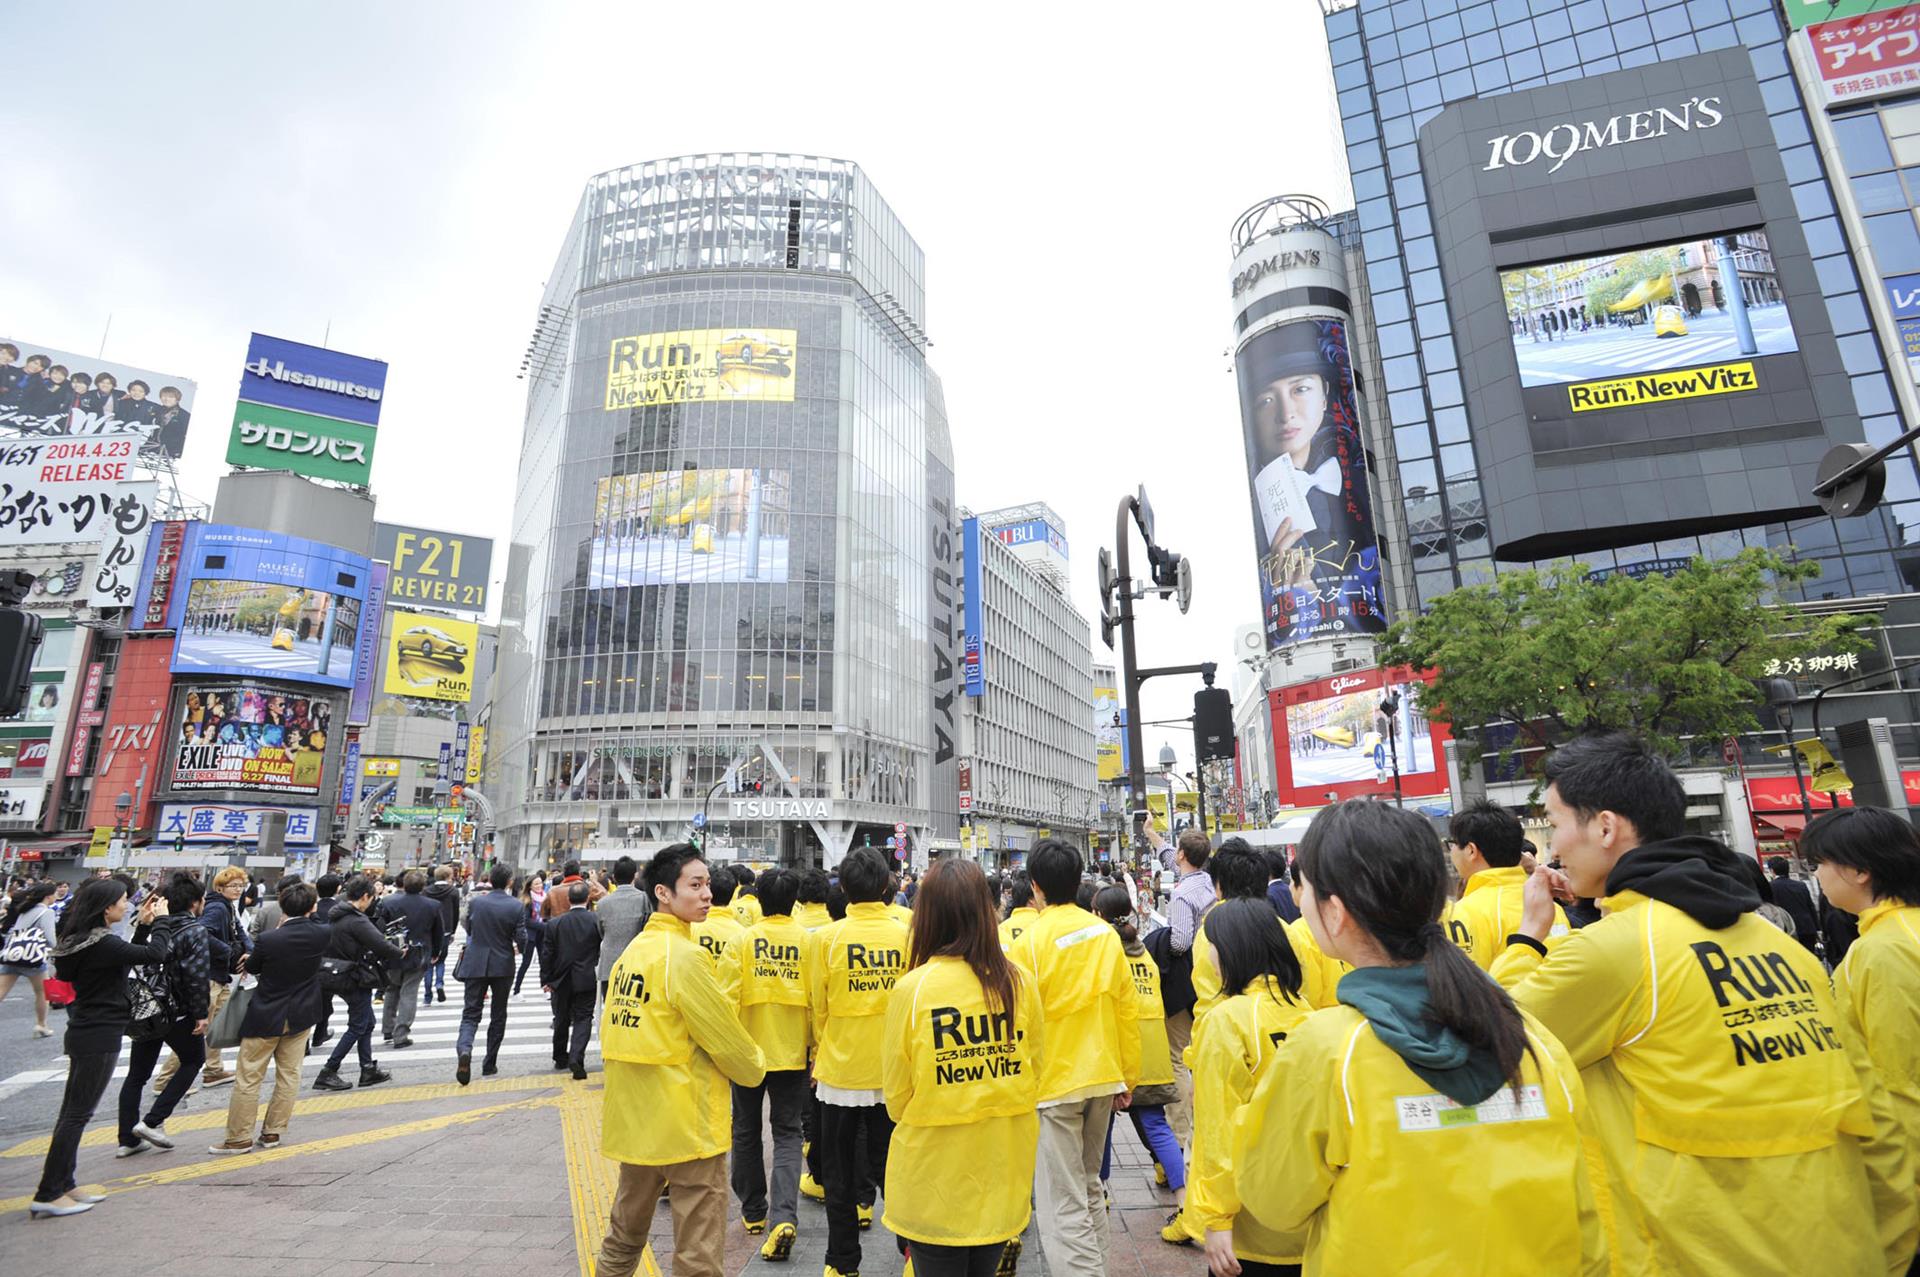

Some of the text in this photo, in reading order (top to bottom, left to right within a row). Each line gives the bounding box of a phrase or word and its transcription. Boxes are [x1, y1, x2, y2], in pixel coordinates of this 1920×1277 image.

[1823, 29, 1920, 69] アイフ
[245, 357, 382, 401] Hisamitsu
[1637, 378, 1697, 399] New
[1697, 368, 1754, 391] Vitz
[609, 380, 705, 407] New Vitz
[46, 442, 132, 459] 2014.4.23
[238, 421, 366, 464] サロンパス
[40, 463, 127, 482] RELEASE
[96, 493, 148, 603] もんじゃ
[393, 532, 463, 578] F21
[463, 586, 483, 605] 21
[933, 498, 955, 766] TSUTAYA
[966, 634, 980, 684] SEIBU
[1330, 677, 1366, 694] Glico
[19, 743, 49, 761] JTB
[101, 710, 162, 776] クスリ
[258, 747, 284, 759] NOW
[593, 745, 688, 758] STARBUCKS
[178, 746, 221, 770] EXILE
[244, 760, 259, 772] ON
[264, 773, 292, 784] FINAL
[733, 800, 829, 817] TSUTAYA
[754, 967, 800, 980] New Vitz
[849, 979, 879, 992] New
[1730, 1030, 1806, 1066] New
[936, 1056, 1022, 1086] New Vitz
